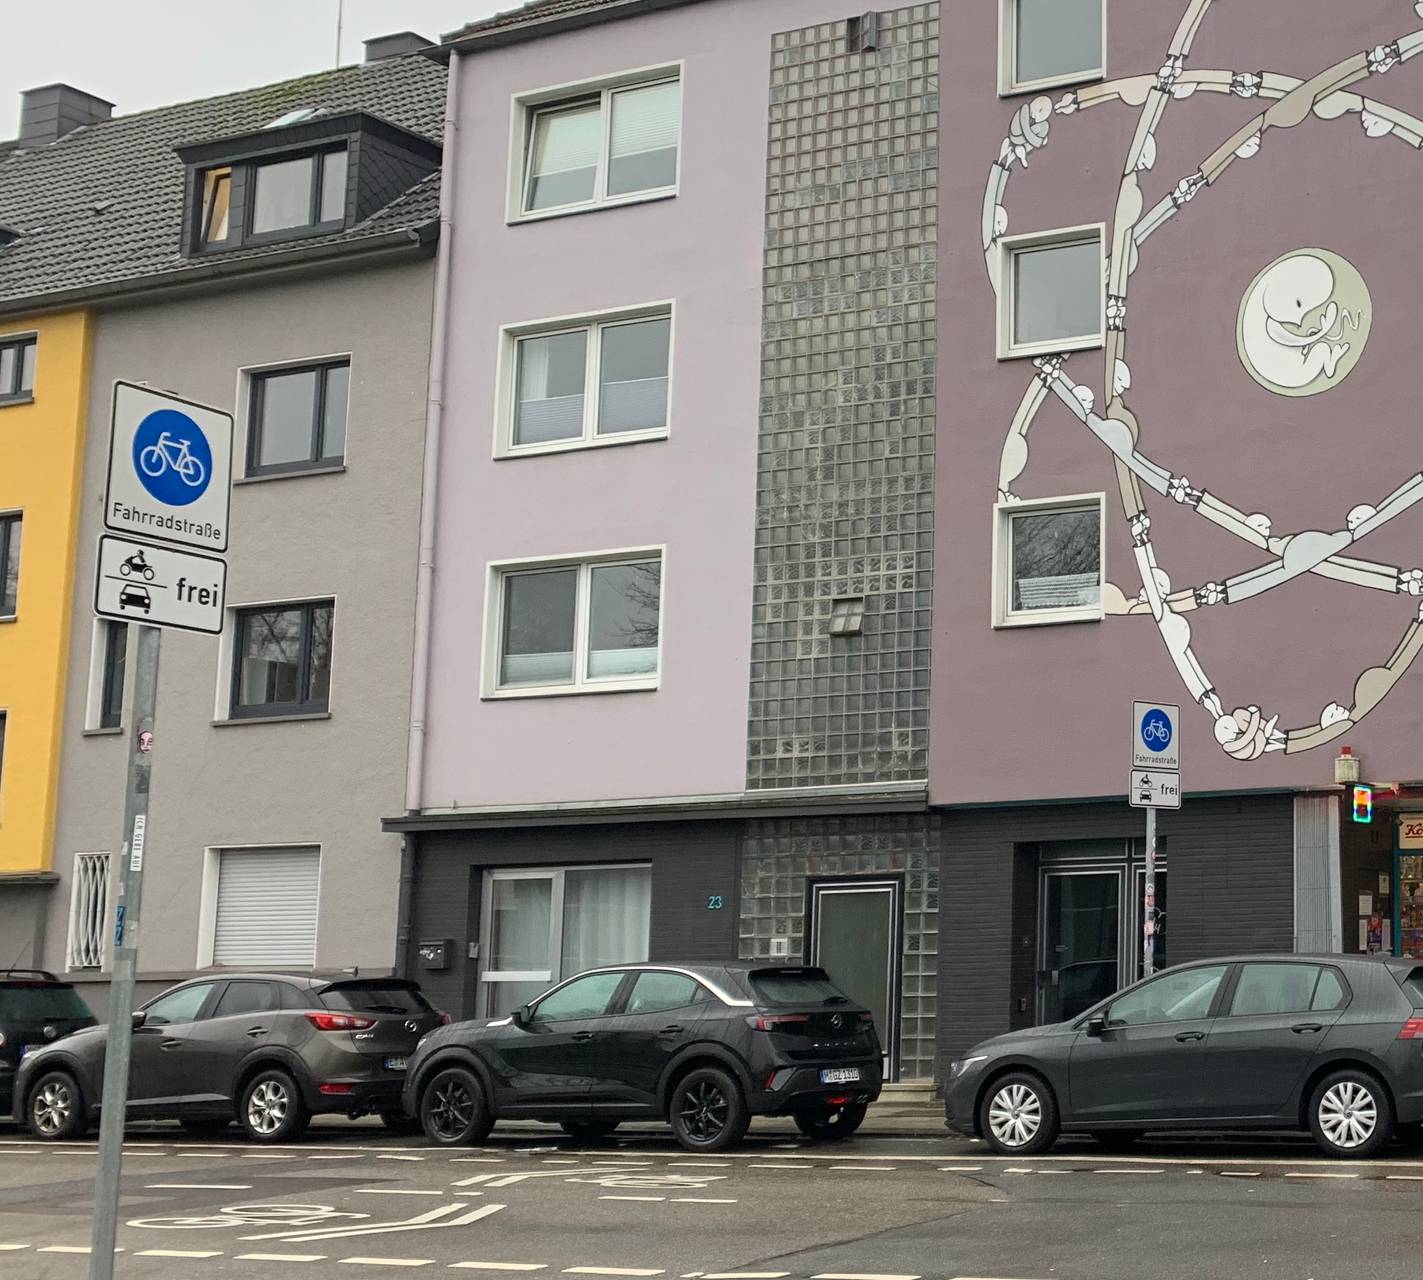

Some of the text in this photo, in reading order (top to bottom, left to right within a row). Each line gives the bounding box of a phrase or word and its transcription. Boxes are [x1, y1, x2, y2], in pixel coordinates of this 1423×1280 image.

[113, 502, 221, 540] Fahrradstraße
[176, 577, 218, 607] frei
[1135, 754, 1177, 765] Fahrradstraße
[1161, 784, 1178, 795] frei
[708, 895, 722, 909] 23
